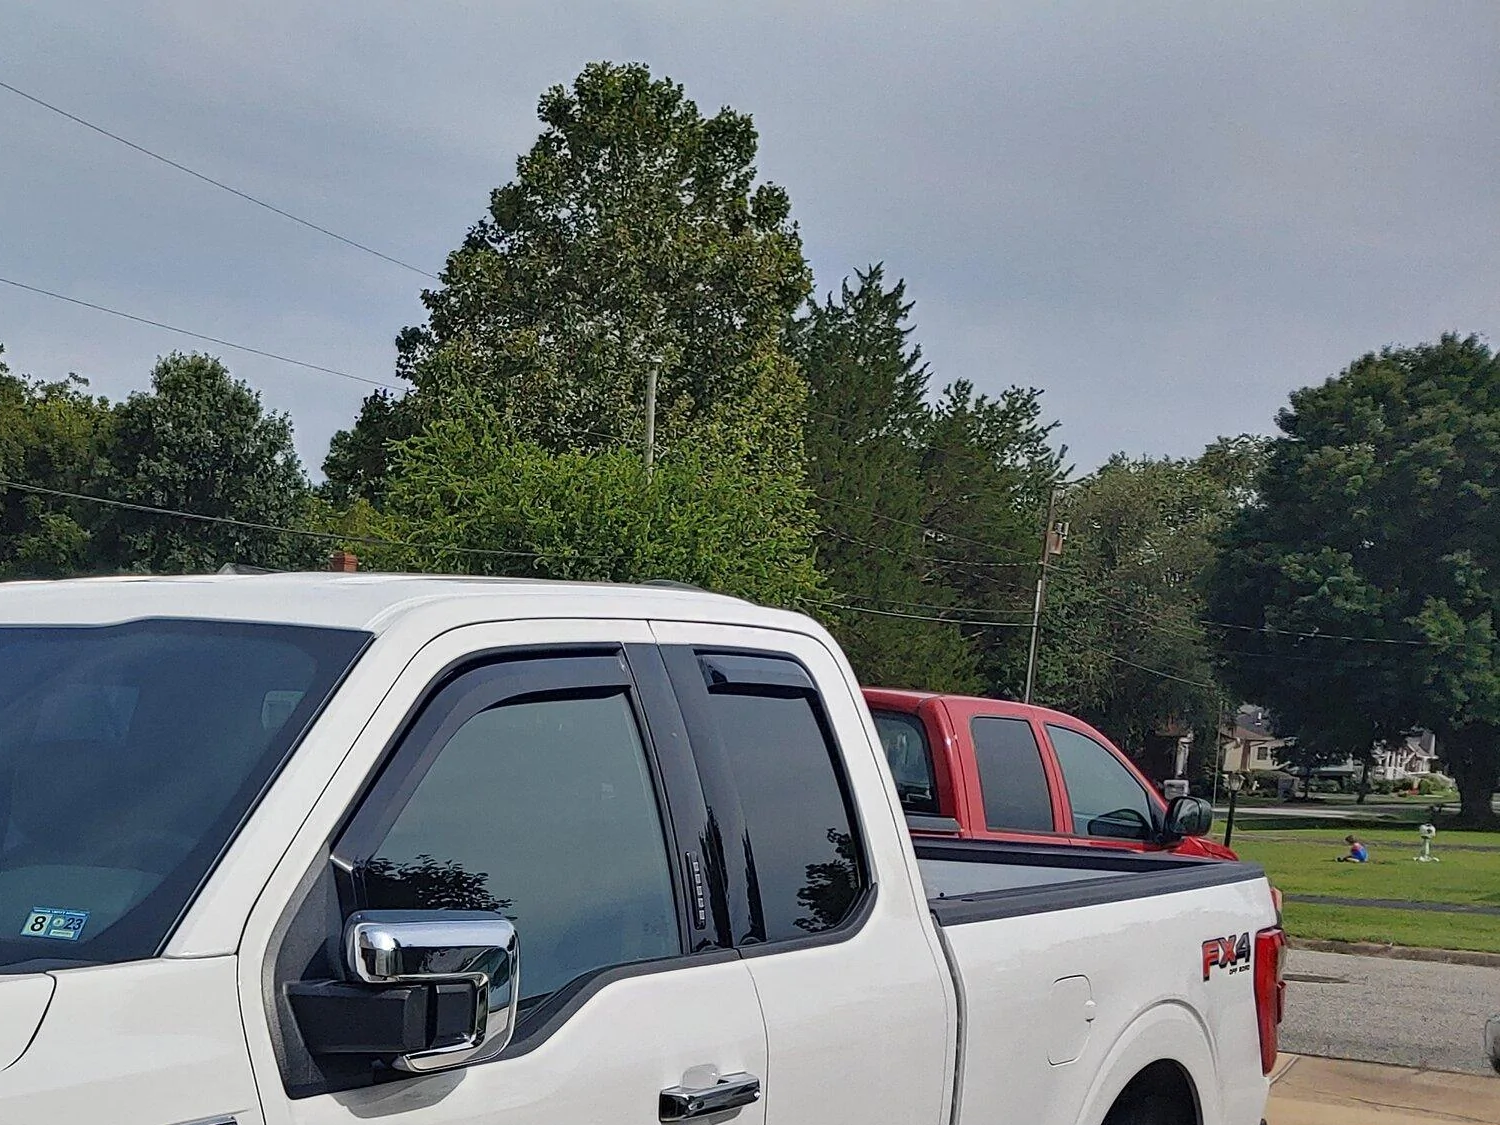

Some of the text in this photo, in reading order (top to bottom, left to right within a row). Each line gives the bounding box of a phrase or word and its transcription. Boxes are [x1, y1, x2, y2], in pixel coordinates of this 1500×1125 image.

[30, 915, 84, 932] 8 23
[1201, 931, 1251, 982] FX4
